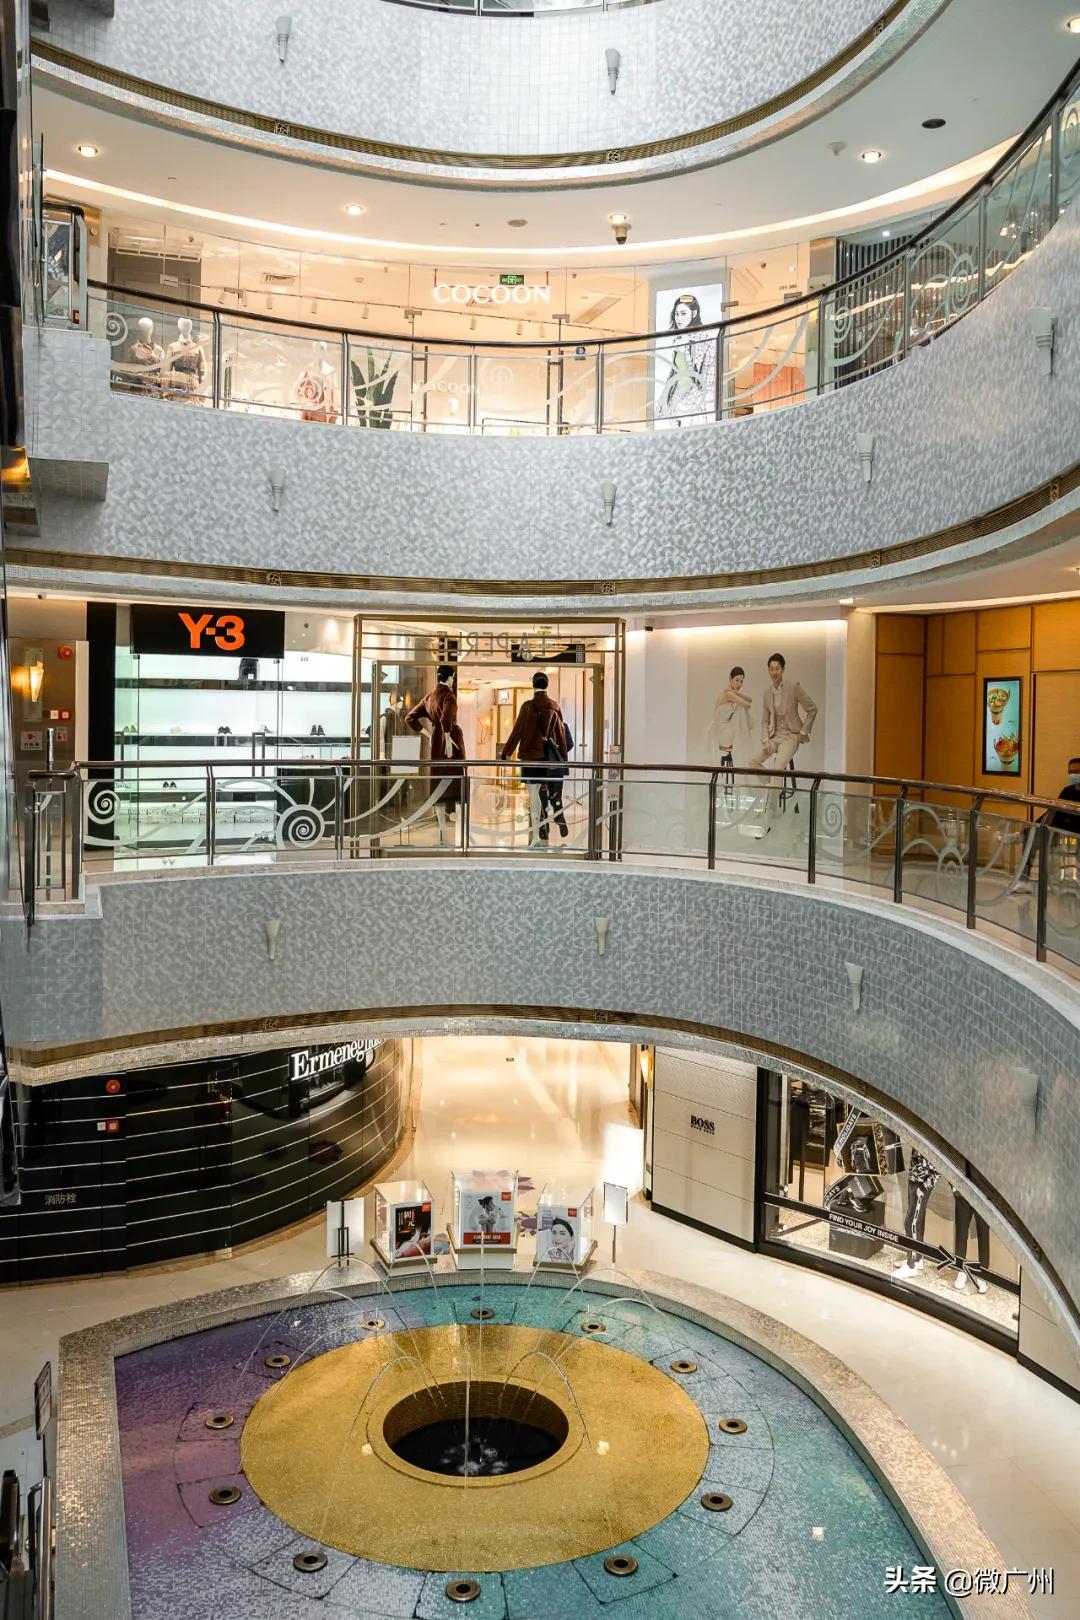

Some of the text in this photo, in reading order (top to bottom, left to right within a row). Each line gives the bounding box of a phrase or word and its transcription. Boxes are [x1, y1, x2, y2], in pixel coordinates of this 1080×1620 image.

[433, 284, 550, 304] COCOON
[178, 612, 245, 651] Y-3
[690, 1115, 715, 1131] BOSS
[829, 1213, 899, 1243] FIND YOUR JOY INSIDE
